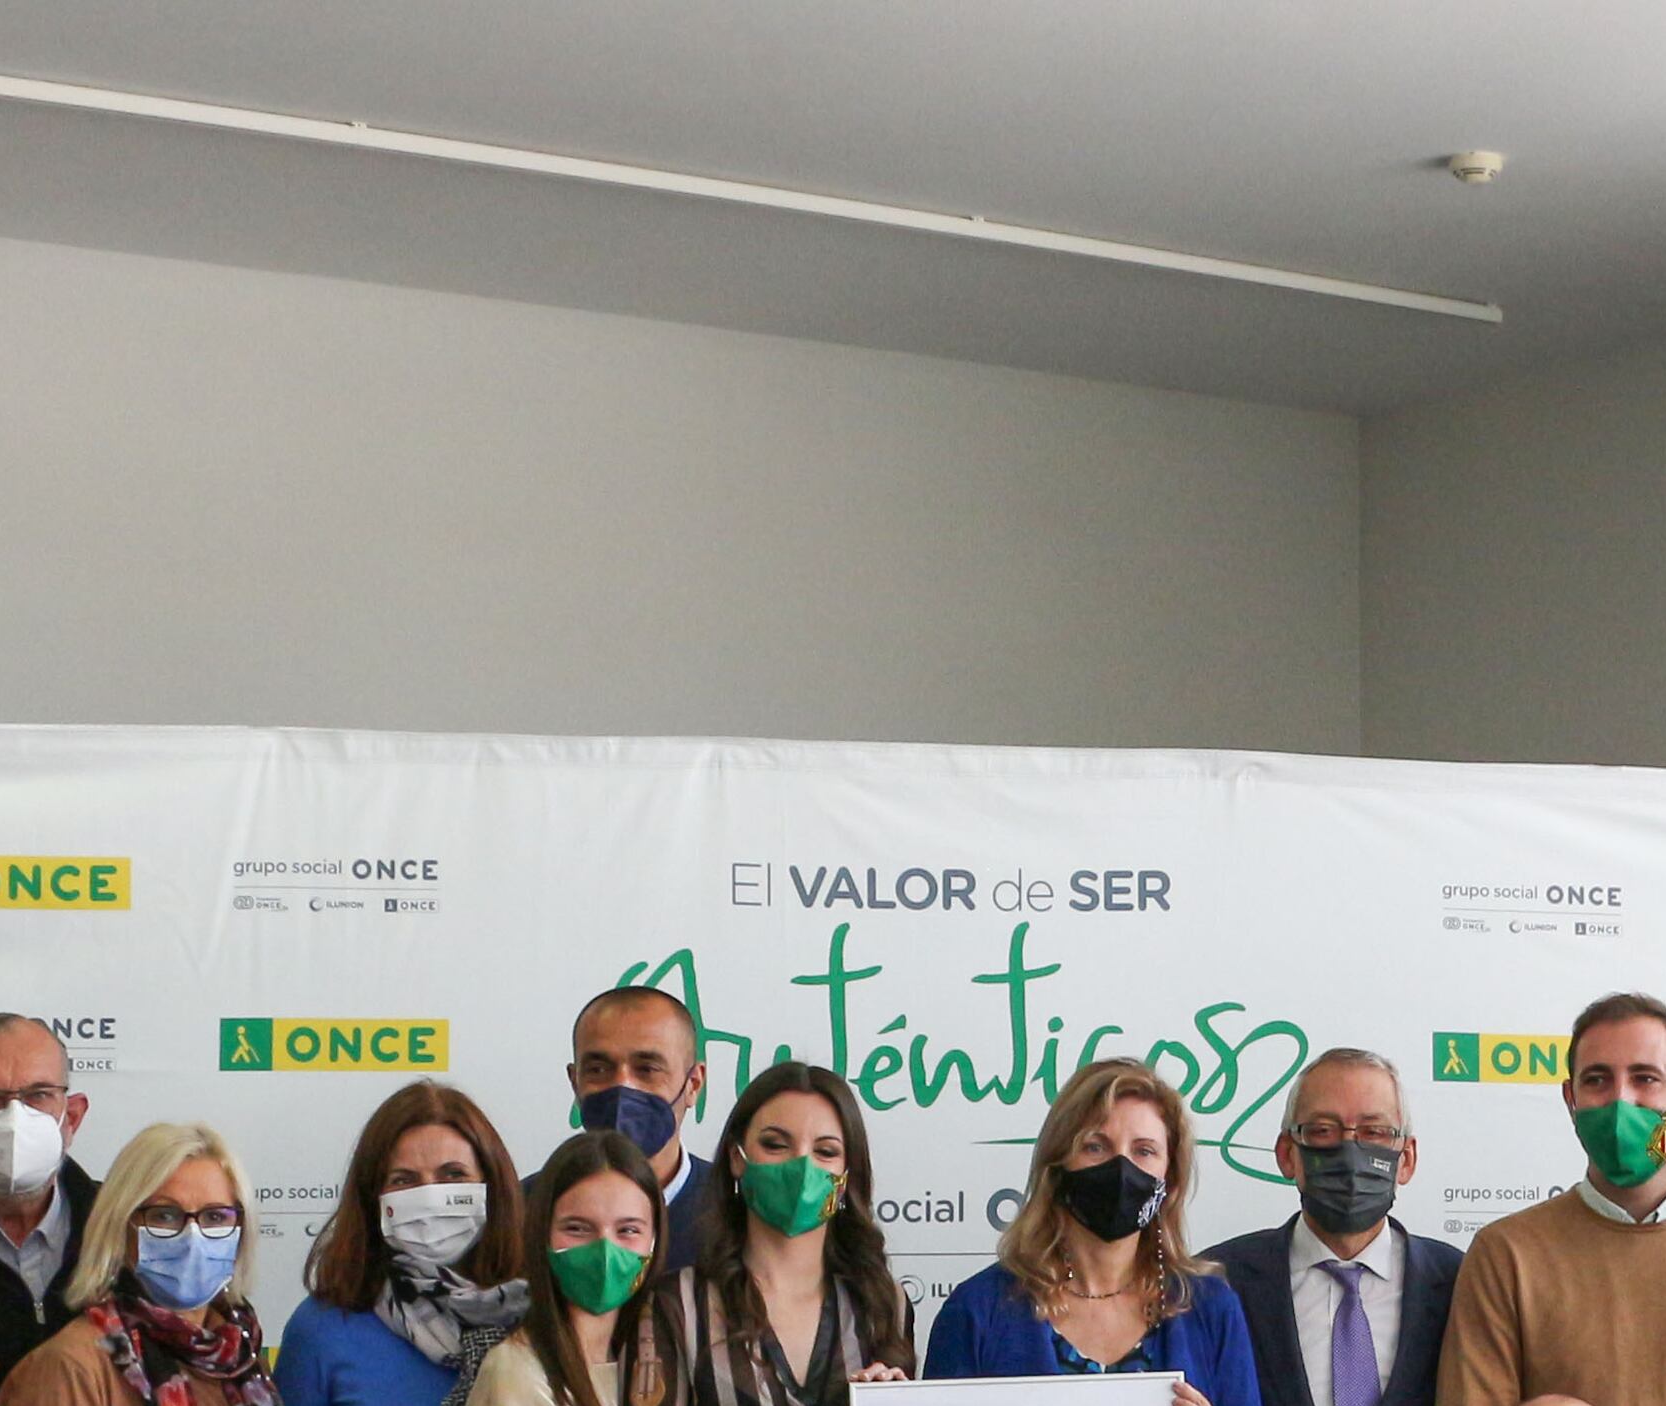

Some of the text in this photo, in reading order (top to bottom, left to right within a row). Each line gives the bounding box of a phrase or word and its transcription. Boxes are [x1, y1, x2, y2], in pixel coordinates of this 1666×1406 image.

[233, 859, 438, 880] grupo social ONCE
[731, 862, 1171, 913] El VALOR de SER
[1442, 885, 1622, 907] grupo social ONCE
[400, 901, 436, 911] ONCE
[1589, 924, 1620, 935] ONCE
[53, 1018, 116, 1040] NCE
[286, 1026, 437, 1064] ONCE
[76, 1060, 113, 1070] ONCE
[1491, 1042, 1569, 1075] ON
[288, 1184, 339, 1200] social
[1444, 1187, 1492, 1202] grupo
[1496, 1185, 1540, 1200] social
[876, 1191, 964, 1223] ocial
